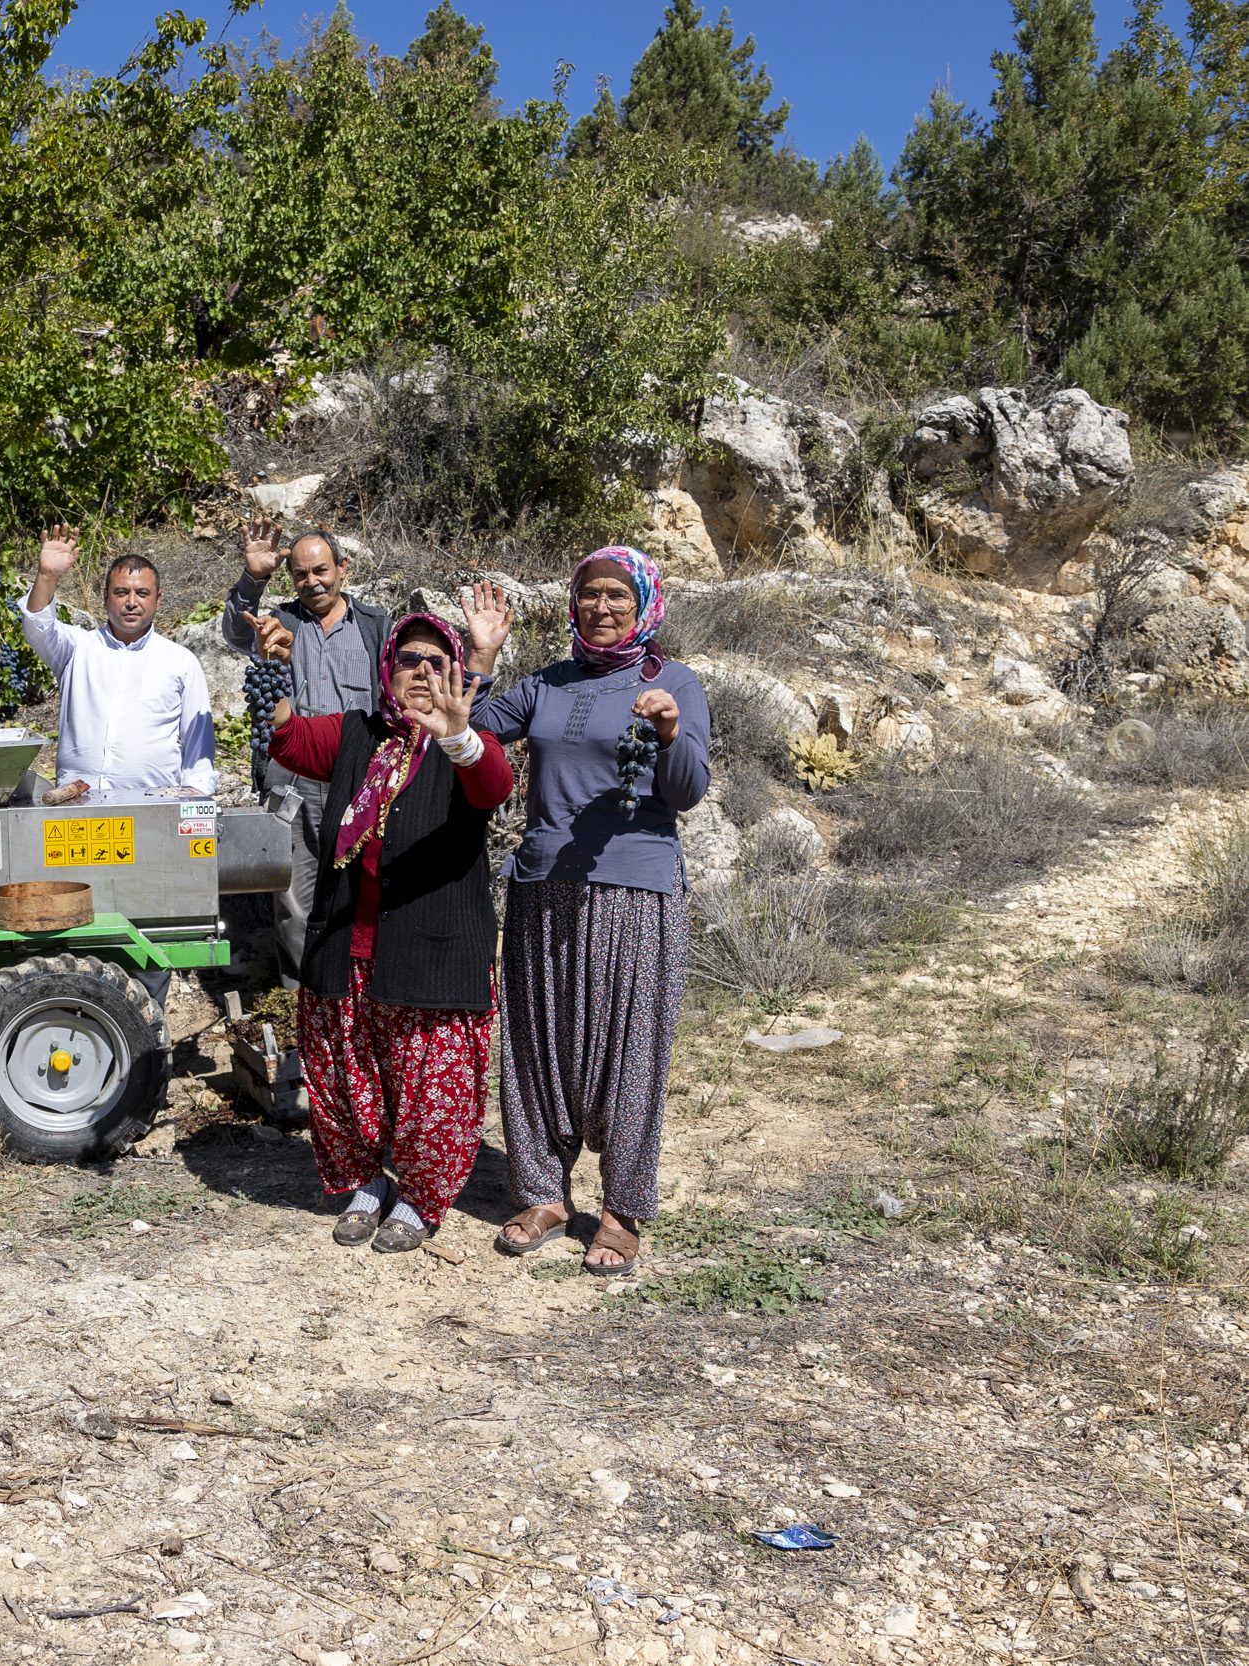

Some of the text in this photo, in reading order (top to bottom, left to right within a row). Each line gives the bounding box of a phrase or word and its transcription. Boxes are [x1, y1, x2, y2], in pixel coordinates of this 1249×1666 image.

[182, 805, 214, 815] HT 1000
[193, 841, 212, 855] CE
